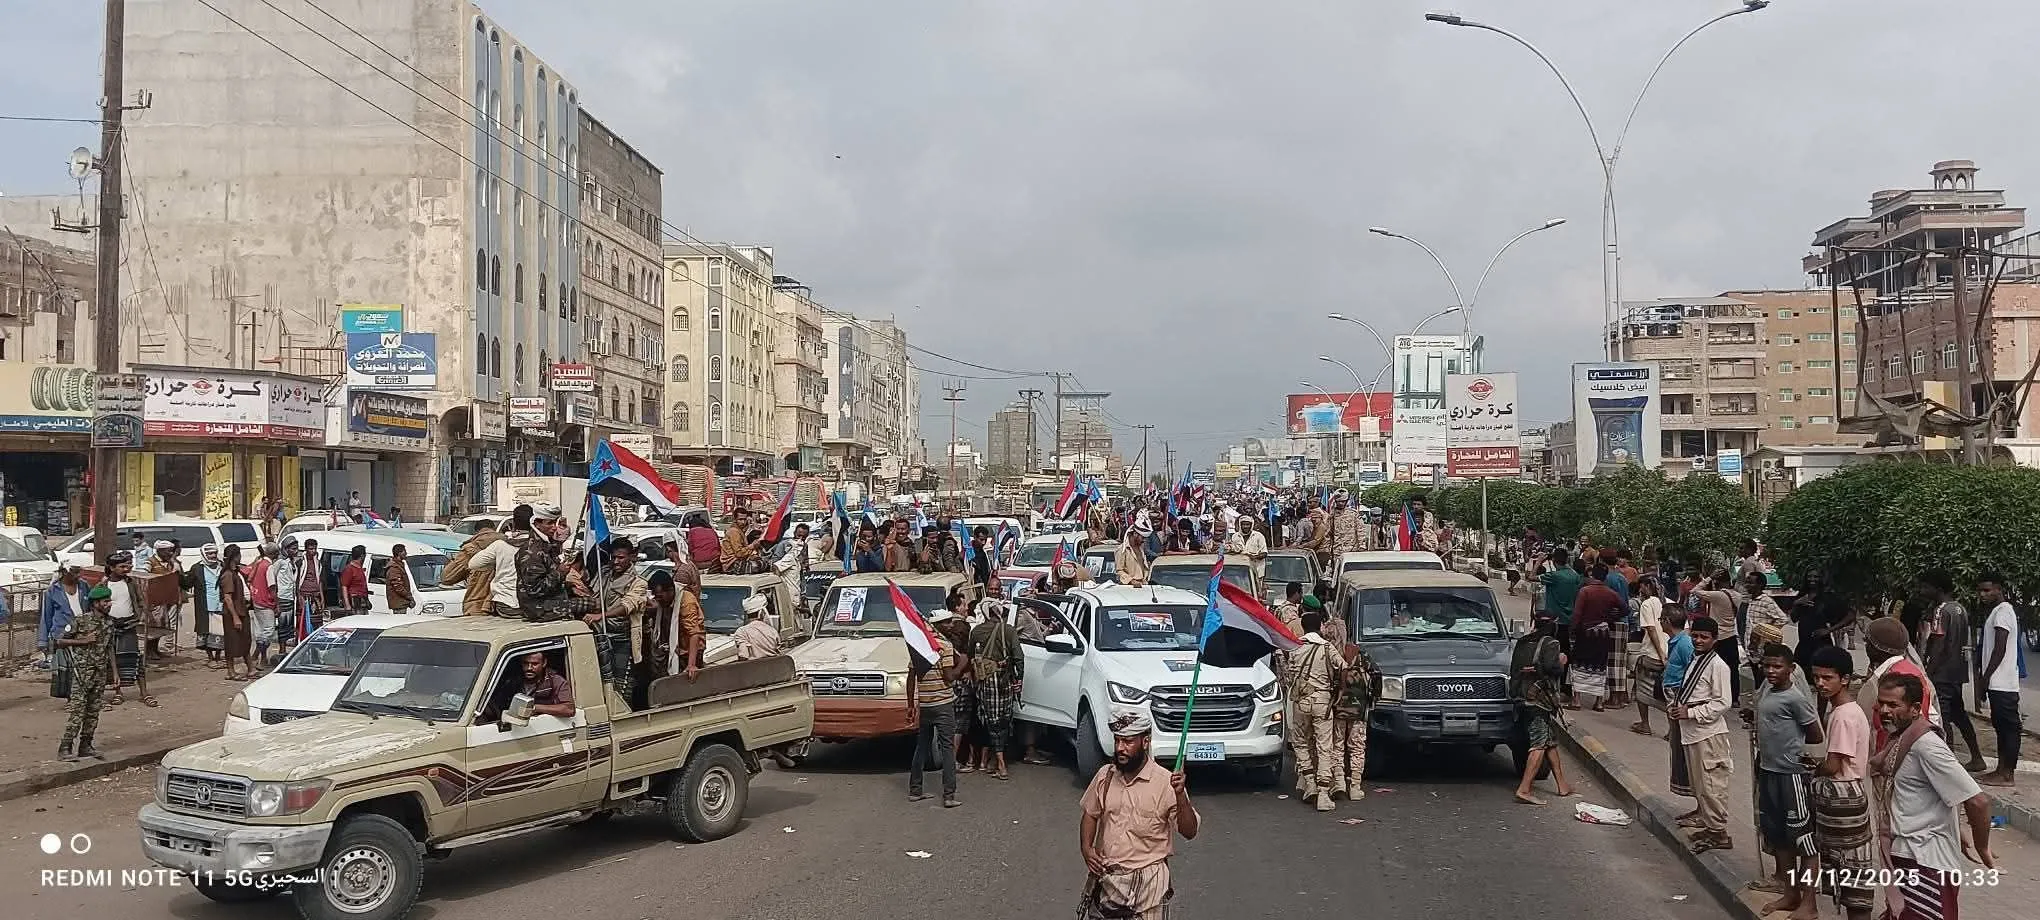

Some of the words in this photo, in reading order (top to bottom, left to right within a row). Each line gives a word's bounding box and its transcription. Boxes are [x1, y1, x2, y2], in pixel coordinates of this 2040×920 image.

[395, 349, 426, 359] محمد
[355, 360, 397, 372] والتحويلات
[398, 360, 426, 372] للصرافة
[554, 366, 592, 378] السعيد
[1589, 370, 1638, 379] بسمتي
[216, 378, 261, 399] كرة
[271, 383, 292, 404] حراري
[1591, 383, 1625, 392] كلاسيك
[303, 386, 322, 406] كرة
[1449, 404, 1483, 422] حراري
[1488, 403, 1513, 418] كرة
[33, 418, 72, 430] العليمي
[205, 424, 233, 434] للتجارة
[235, 424, 263, 434] الشامل
[1451, 449, 1481, 461] للتجارة
[1484, 449, 1514, 460] الشامل
[1436, 684, 1474, 692] TOYOTA
